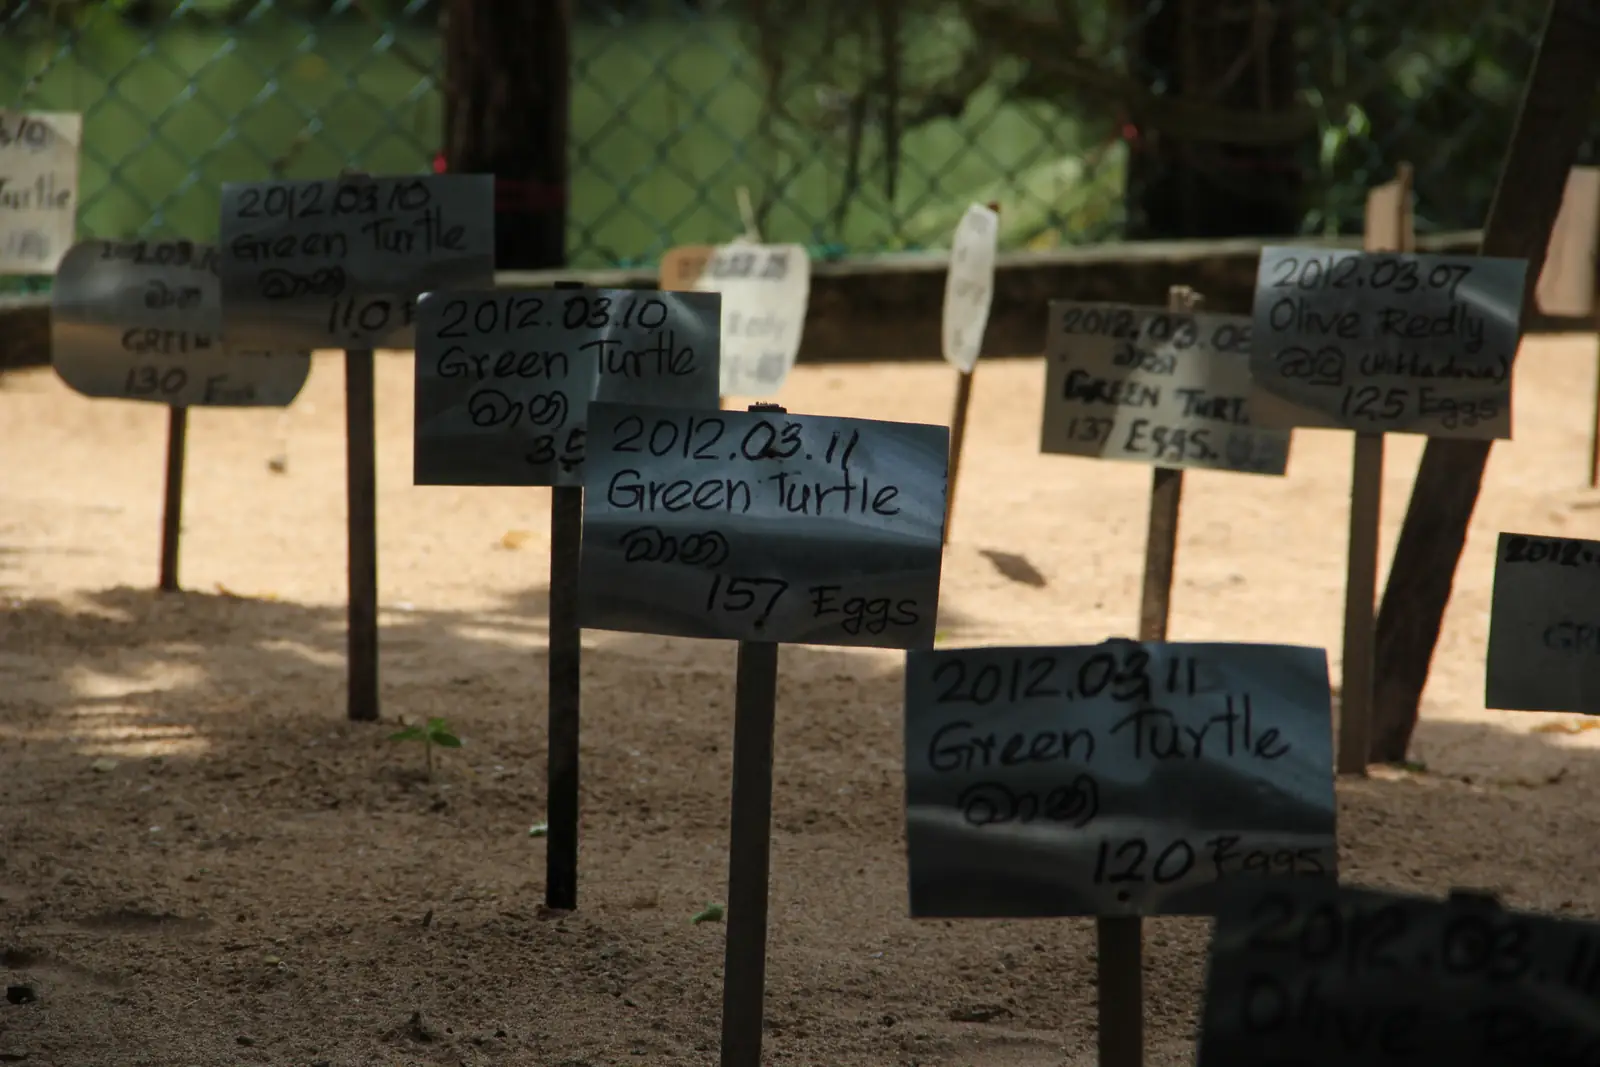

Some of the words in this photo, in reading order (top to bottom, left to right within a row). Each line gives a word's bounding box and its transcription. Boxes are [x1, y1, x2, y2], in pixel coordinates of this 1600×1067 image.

[231, 230, 348, 262] Green
[360, 204, 467, 254] Turtle
[1273, 255, 1473, 299] 2012.03.07
[436, 296, 667, 339] 2012.03.10
[1270, 296, 1362, 338] Olive
[1377, 303, 1485, 351] Redly
[436, 345, 569, 380] Green
[578, 330, 697, 379] Turtle
[1341, 385, 1409, 422] 125
[612, 415, 859, 468] 2012.03.11
[607, 469, 751, 513] Green
[769, 470, 902, 515] Turtle
[706, 573, 790, 620] 157
[808, 584, 920, 635] Eggs
[927, 720, 1096, 772] Green
[1110, 693, 1291, 760] Turtle
